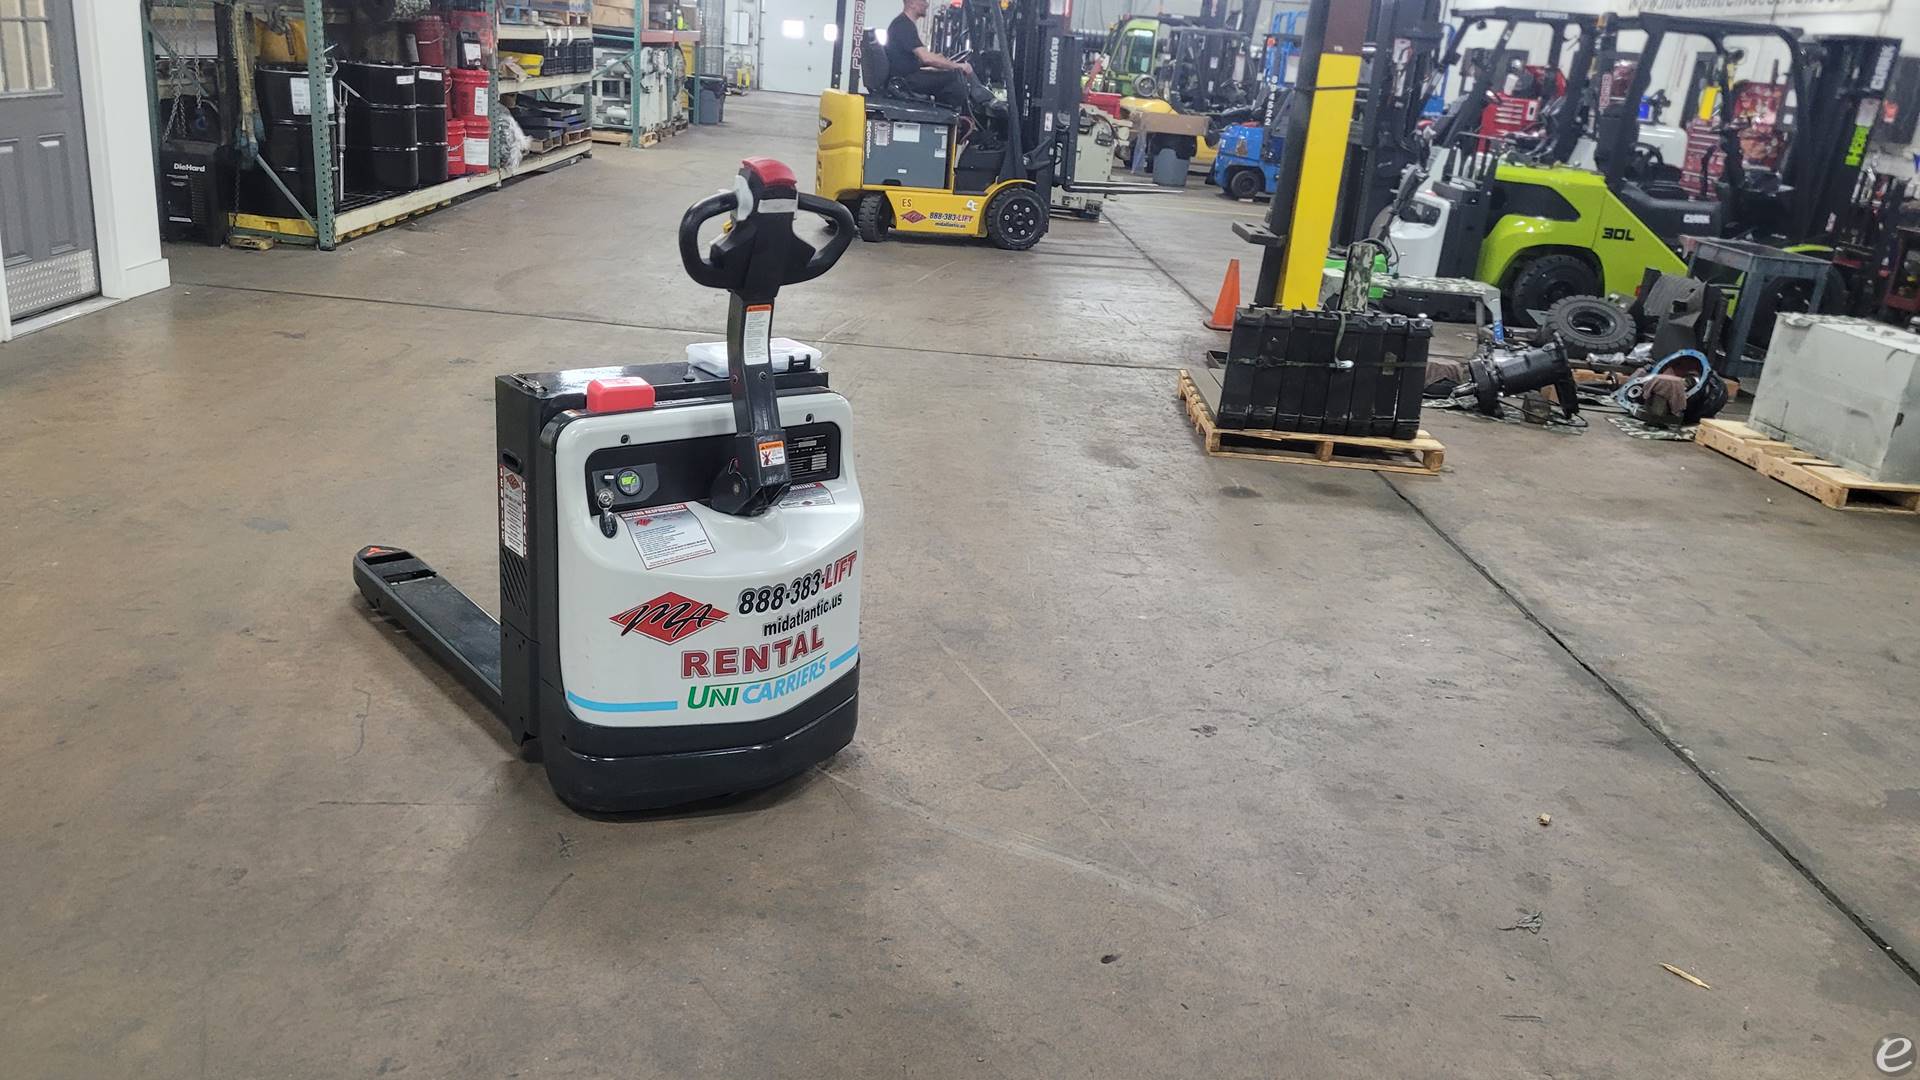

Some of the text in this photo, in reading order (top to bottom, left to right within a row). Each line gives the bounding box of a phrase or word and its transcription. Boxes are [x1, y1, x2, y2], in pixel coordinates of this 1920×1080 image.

[852, 1, 865, 69] RENTAL
[1049, 37, 1060, 85] KOMATSU
[173, 163, 206, 172] DieHard
[1602, 228, 1635, 241] 30L
[763, 593, 843, 637] midatlantic.us
[681, 626, 825, 679] RENTAL
